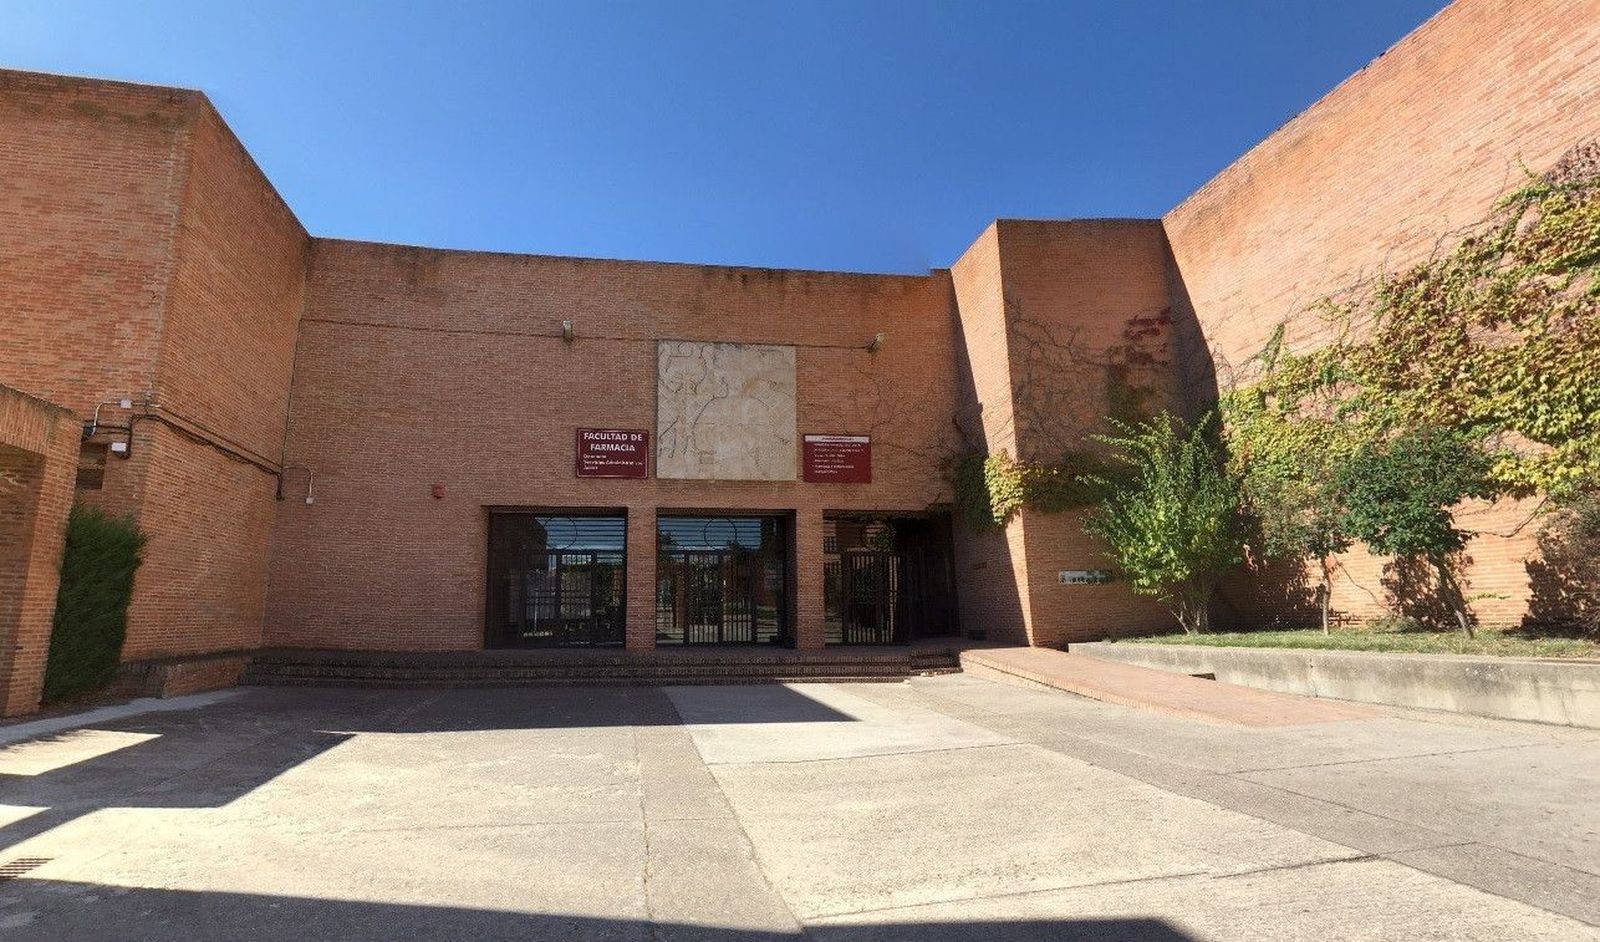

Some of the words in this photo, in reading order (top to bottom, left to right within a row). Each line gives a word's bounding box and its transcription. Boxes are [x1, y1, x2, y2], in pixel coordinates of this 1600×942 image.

[584, 432, 628, 440] FACULTAD
[630, 434, 643, 442] DE
[590, 444, 636, 452] FARMACIA
